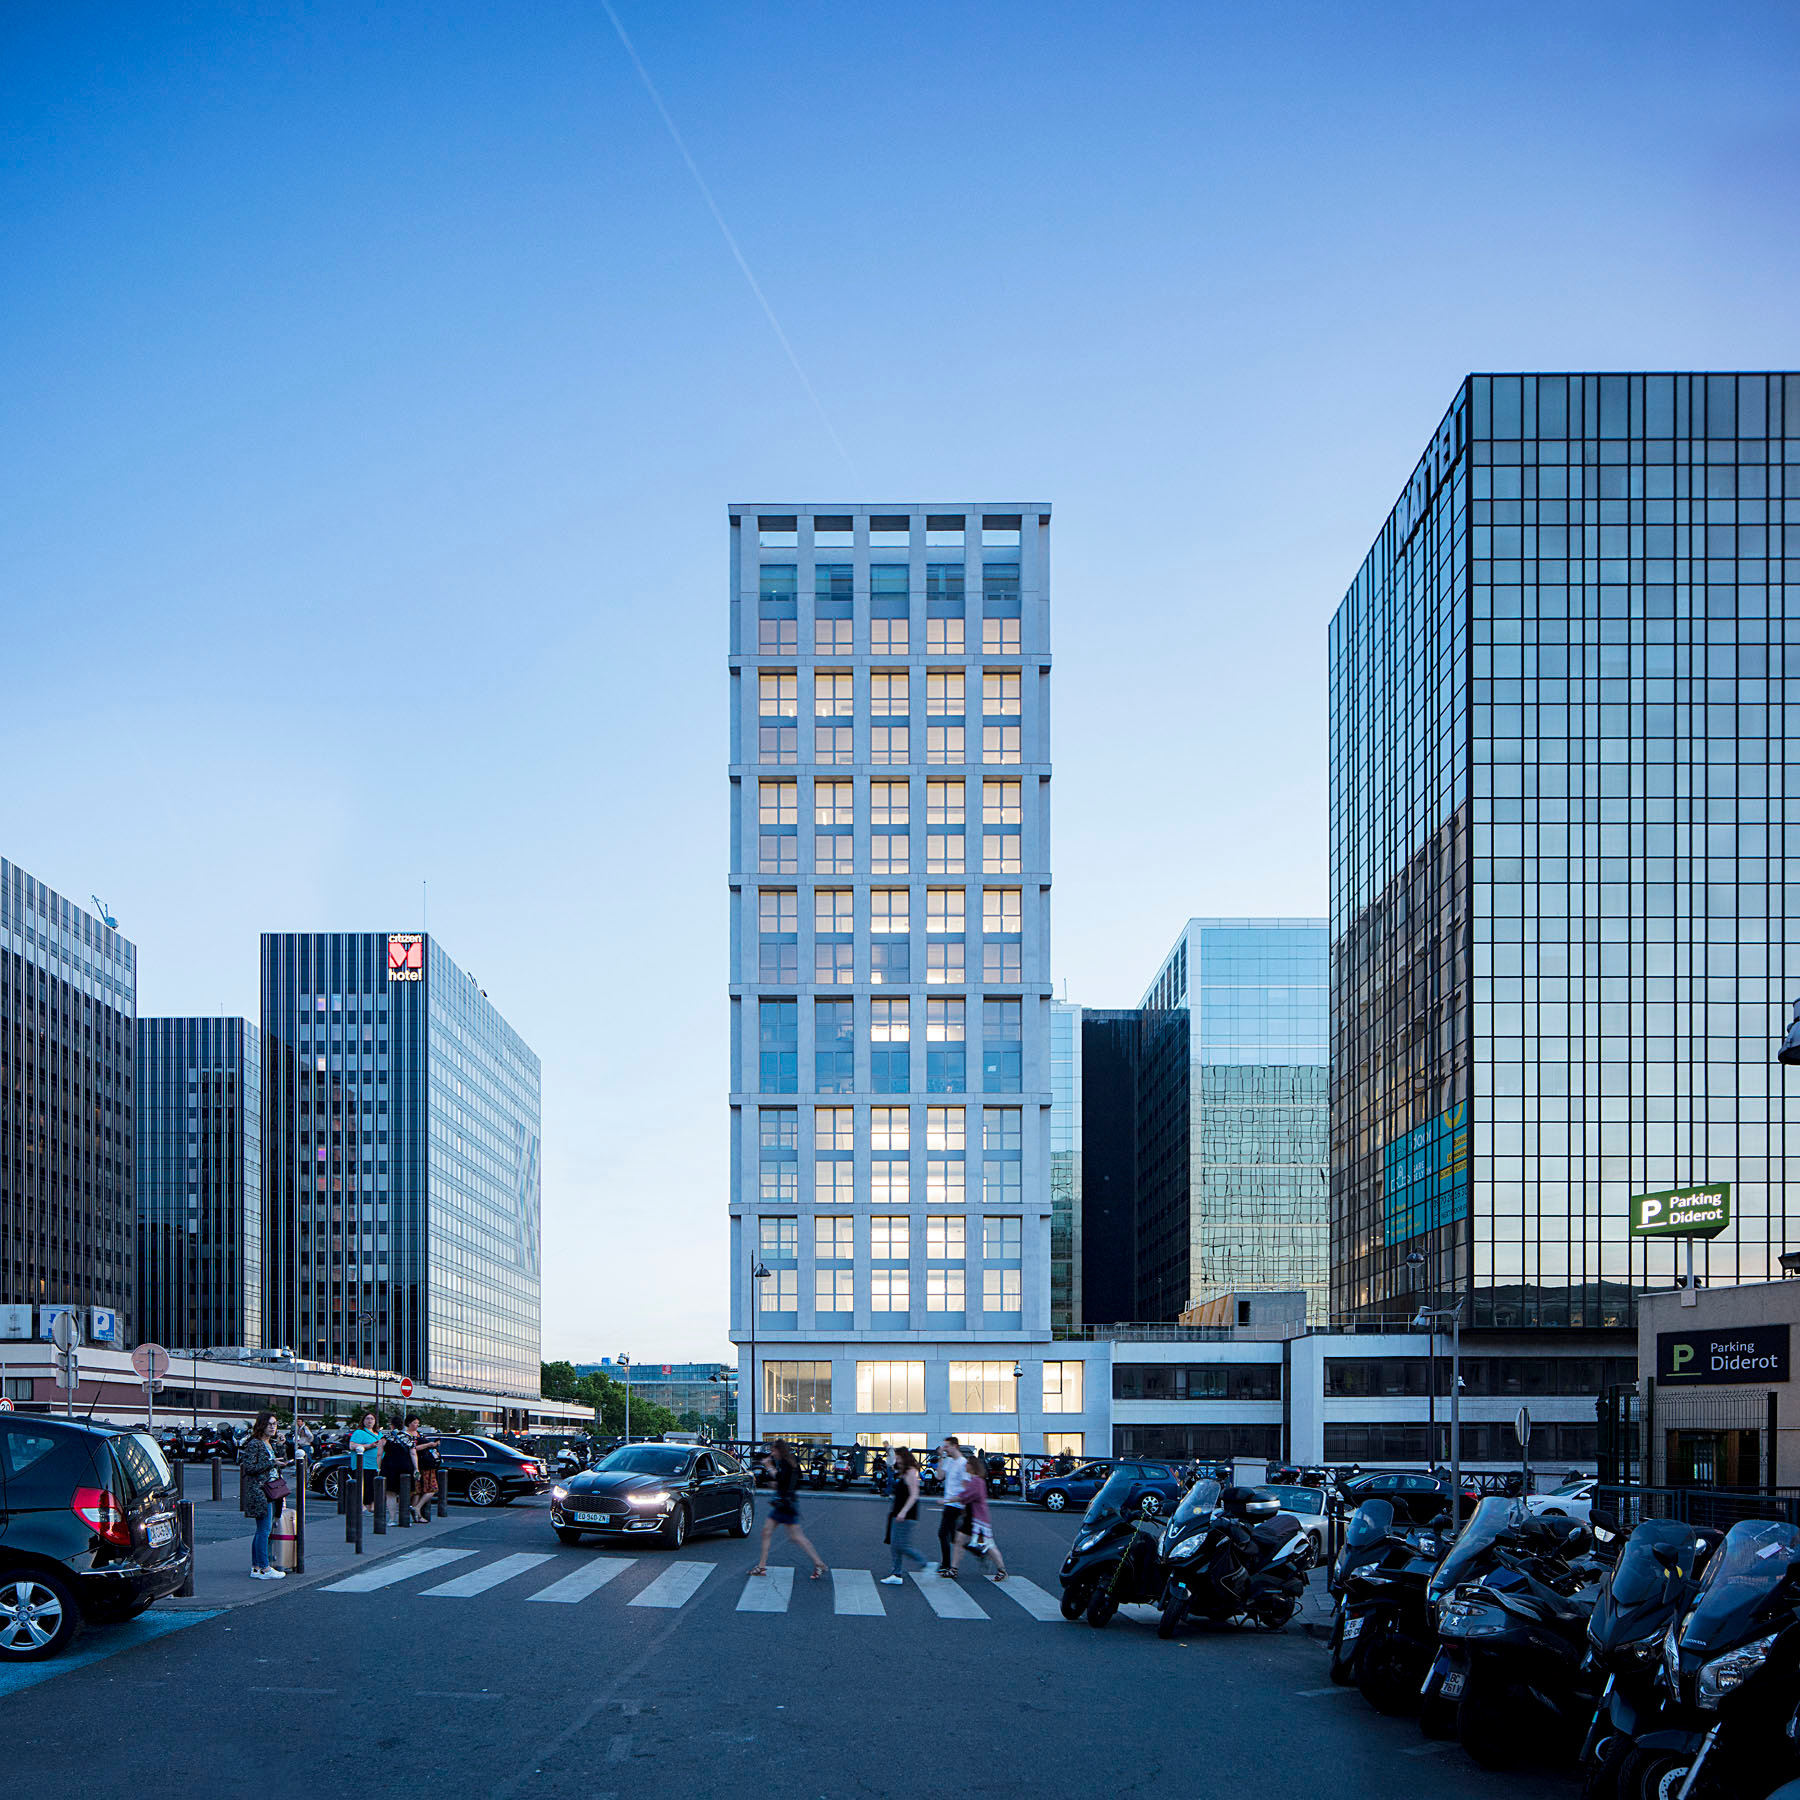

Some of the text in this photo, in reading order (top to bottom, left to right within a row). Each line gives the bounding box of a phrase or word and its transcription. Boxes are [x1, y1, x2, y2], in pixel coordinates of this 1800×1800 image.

[388, 967, 422, 981] hotel
[1642, 1193, 1722, 1225] P Parking
[1669, 1209, 1723, 1225] Diderot
[1673, 1342, 1755, 1371] P Parking
[1711, 1354, 1779, 1371] Diderot
